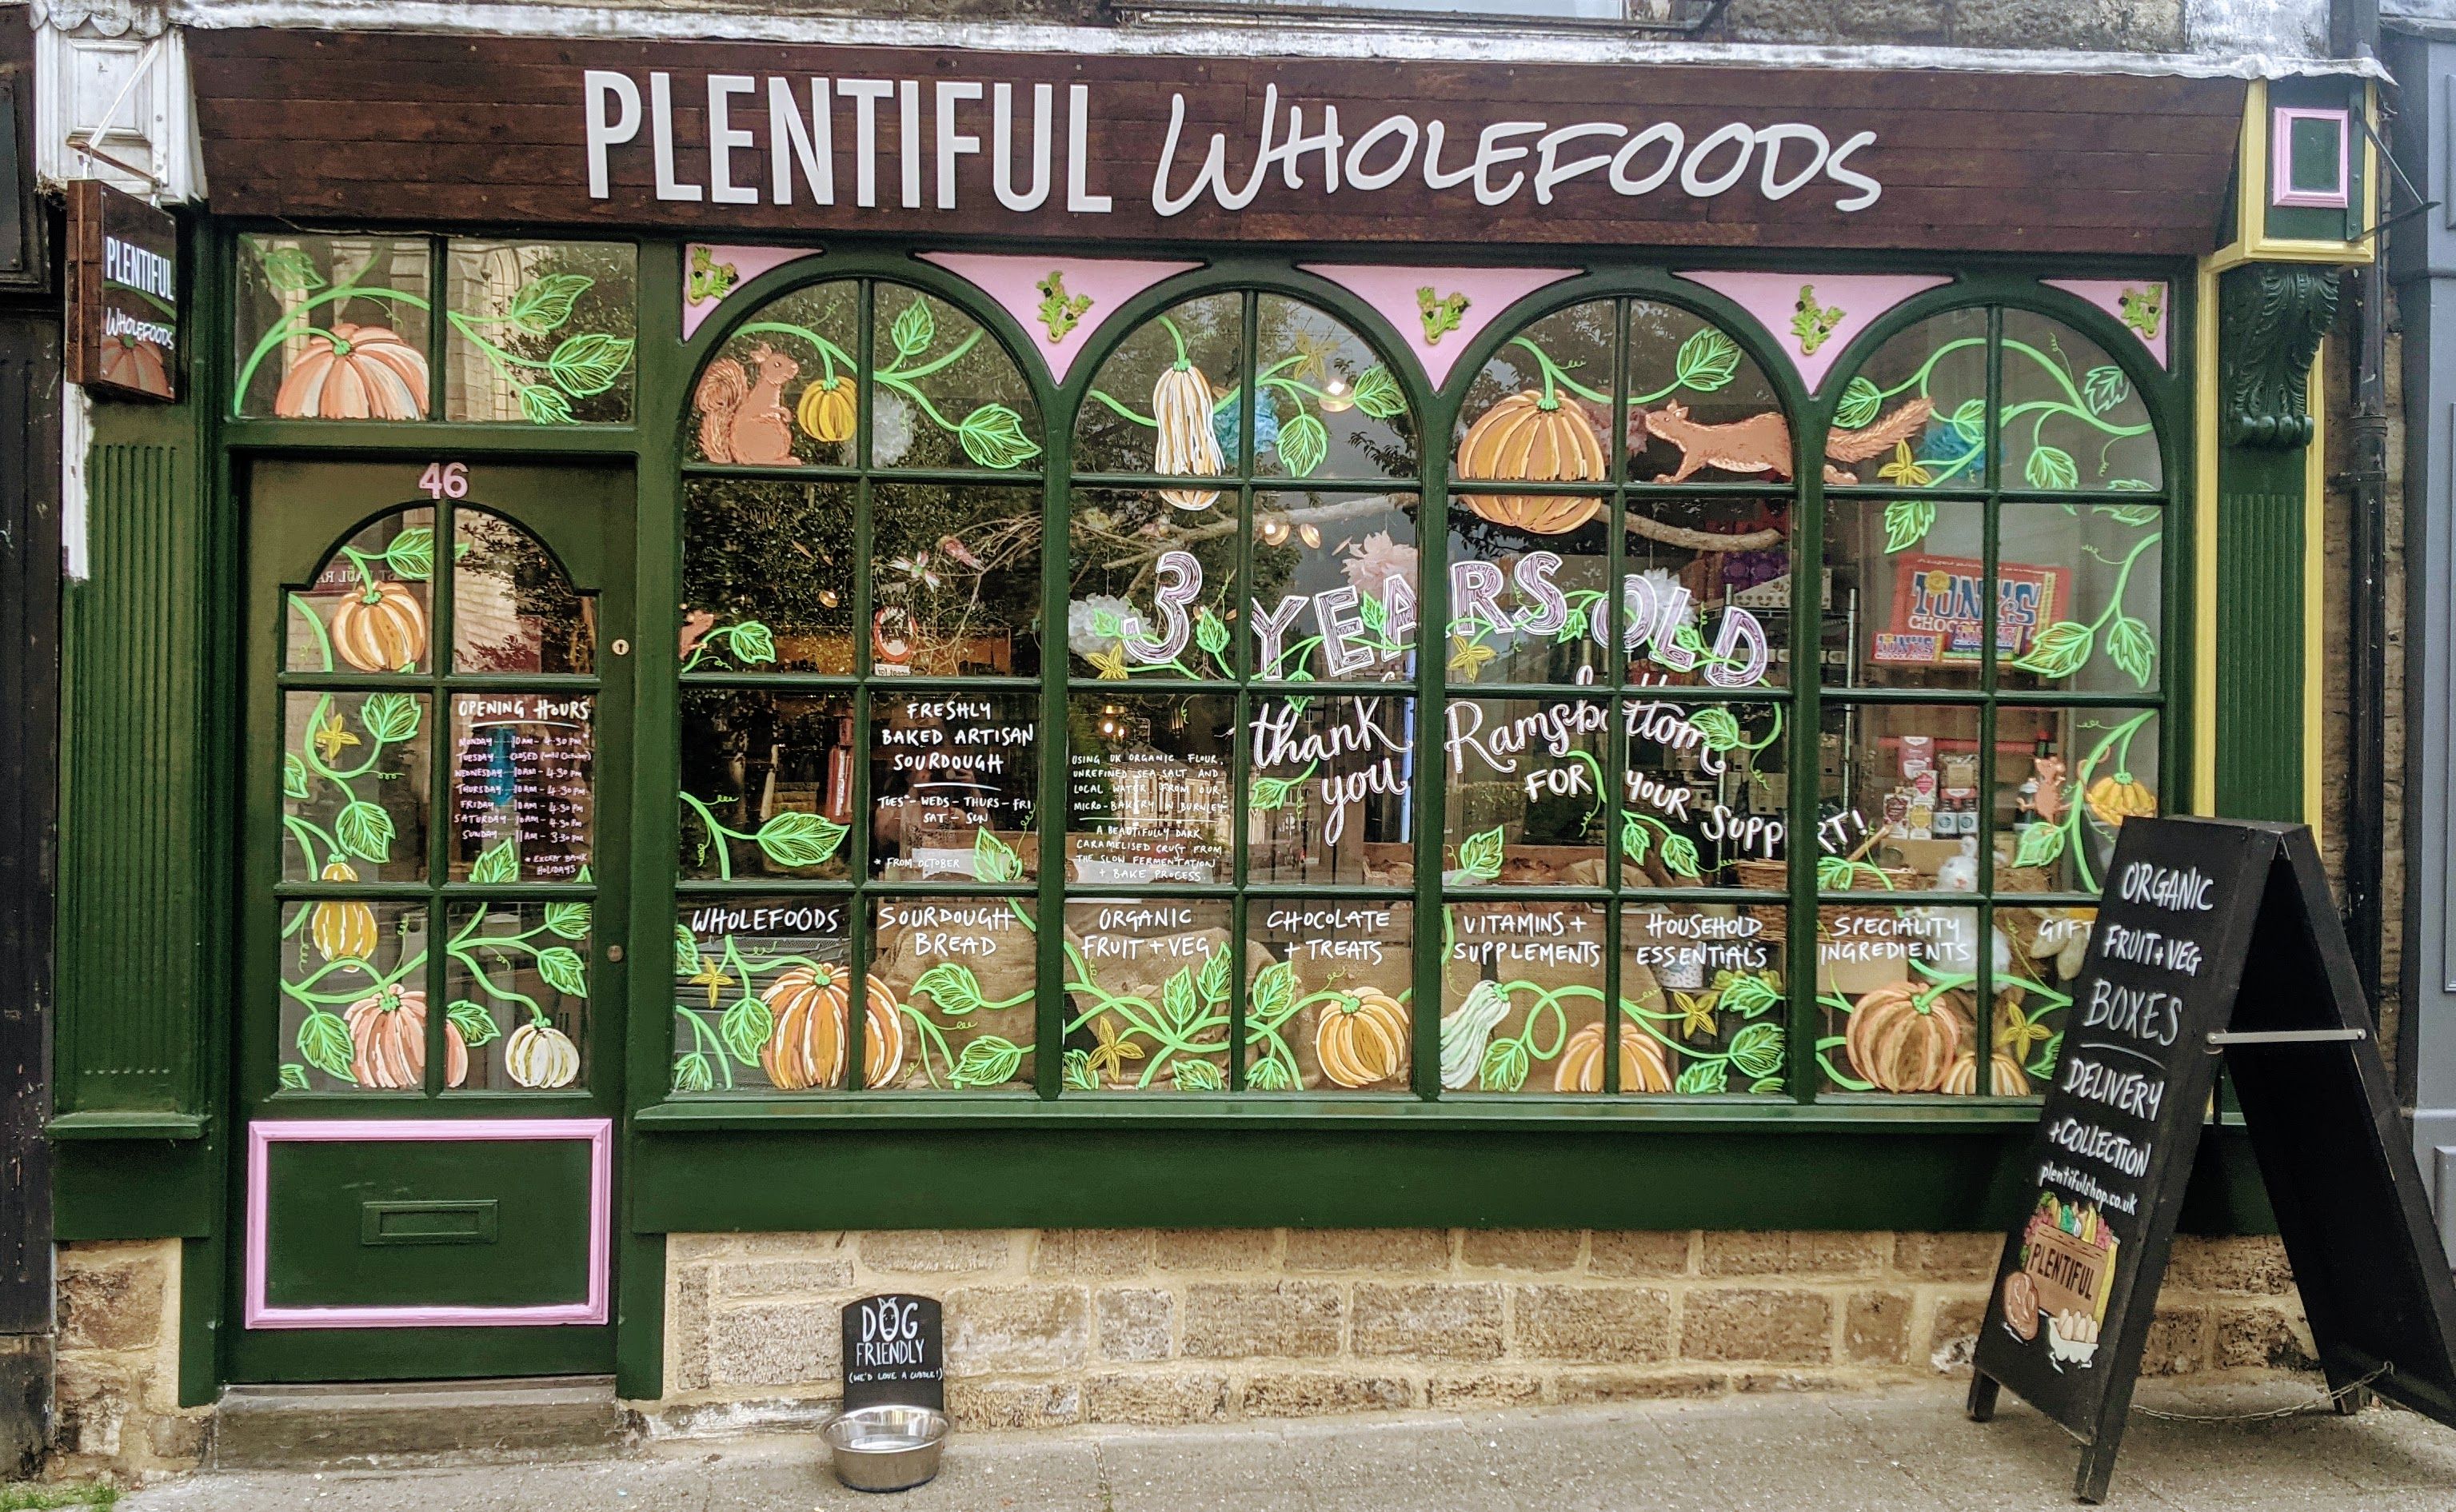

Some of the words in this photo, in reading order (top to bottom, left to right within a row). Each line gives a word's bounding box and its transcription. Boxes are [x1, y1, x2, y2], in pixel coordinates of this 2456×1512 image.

[585, 70, 1112, 213] PLENTIFUL
[1152, 82, 1882, 217] WHOLEFOODS
[106, 236, 174, 301] PLENTIFUL
[106, 307, 175, 350] WHOLEFOODS
[418, 462, 469, 500] 46
[1120, 550, 1203, 664] 3
[1251, 550, 1567, 682] YEARS
[1591, 574, 1767, 688] OLD
[458, 700, 525, 719] OPENING
[533, 700, 589, 720] HOURS
[907, 701, 991, 720] FRESHLY
[458, 737, 493, 747] MONDAY
[881, 728, 943, 746] BAKED
[954, 723, 1034, 747] ARTISAN
[455, 751, 494, 763] TUESDAY
[893, 752, 1004, 775] SOURDOUGH
[1072, 755, 1100, 765] USING
[1109, 754, 1121, 763] UK
[1128, 753, 1175, 764] ORGANIC
[453, 768, 503, 778] WEDNESDAY
[1072, 768, 1128, 779] UNREFINED
[1136, 769, 1156, 779] SEA
[1162, 768, 1188, 778] SALT
[1198, 768, 1218, 778] AND
[455, 784, 502, 795] THURSDAY
[1074, 784, 1104, 794] LOCAL
[1200, 785, 1220, 795] OUR
[460, 800, 494, 812] FRIDAY
[921, 796, 950, 808] WEDS
[963, 796, 1000, 808] THURS
[1013, 799, 1032, 812] FRI
[1321, 758, 1408, 848] you
[1524, 764, 1593, 804] FOR
[1625, 769, 1692, 823] YOUR
[1700, 804, 1868, 858] SUPPRT!
[453, 813, 507, 824] SATURDAY
[923, 812, 948, 824] SAT
[965, 812, 988, 824] SUN
[461, 829, 497, 840] SUNDAY
[1096, 825, 1104, 836] A
[1108, 825, 1169, 841] BEAUTIFULLY
[1176, 829, 1204, 840] DARK
[1076, 839, 1151, 852] CARAMELISED
[1156, 843, 1186, 860] CRUST
[1193, 845, 1222, 856] FROM
[1076, 854, 1094, 863] THE
[1100, 855, 1125, 864] SLOW
[1132, 856, 1216, 869] FERMENTATION
[886, 857, 913, 869] FROM
[918, 858, 960, 869] OCTOBER
[1112, 868, 1147, 880] BAKE
[2122, 861, 2214, 912] ORGANIC
[692, 907, 841, 934] WHOLEFOODS
[878, 906, 1016, 932] SOURDOUGH
[1099, 907, 1192, 932] ORGANIC
[1266, 909, 1391, 933] CHOCOLATE
[1464, 912, 1565, 938] VITAMINS
[1644, 913, 1763, 940] HOUSEHOLD
[1831, 916, 1960, 939] SPECIALITY
[914, 932, 997, 958] BREAD
[1080, 935, 1144, 960] FRUIT
[1168, 937, 1210, 960] VEG
[1306, 940, 1384, 966] TREATS
[1453, 941, 1602, 967] SUPPLEMENTS
[1635, 942, 1767, 969] ESSENTIALS
[1820, 941, 1972, 965] INGREDIENTS
[2082, 978, 2182, 1047] BOXES
[2062, 1057, 2165, 1122] DELIVERY
[2028, 1243, 2096, 1302] PLENTIFUL
[861, 1299, 919, 1342] DOG
[856, 1338, 925, 1367] FRIENDLY
[877, 1371, 897, 1381] LOVE
[901, 1370, 908, 1380] A
